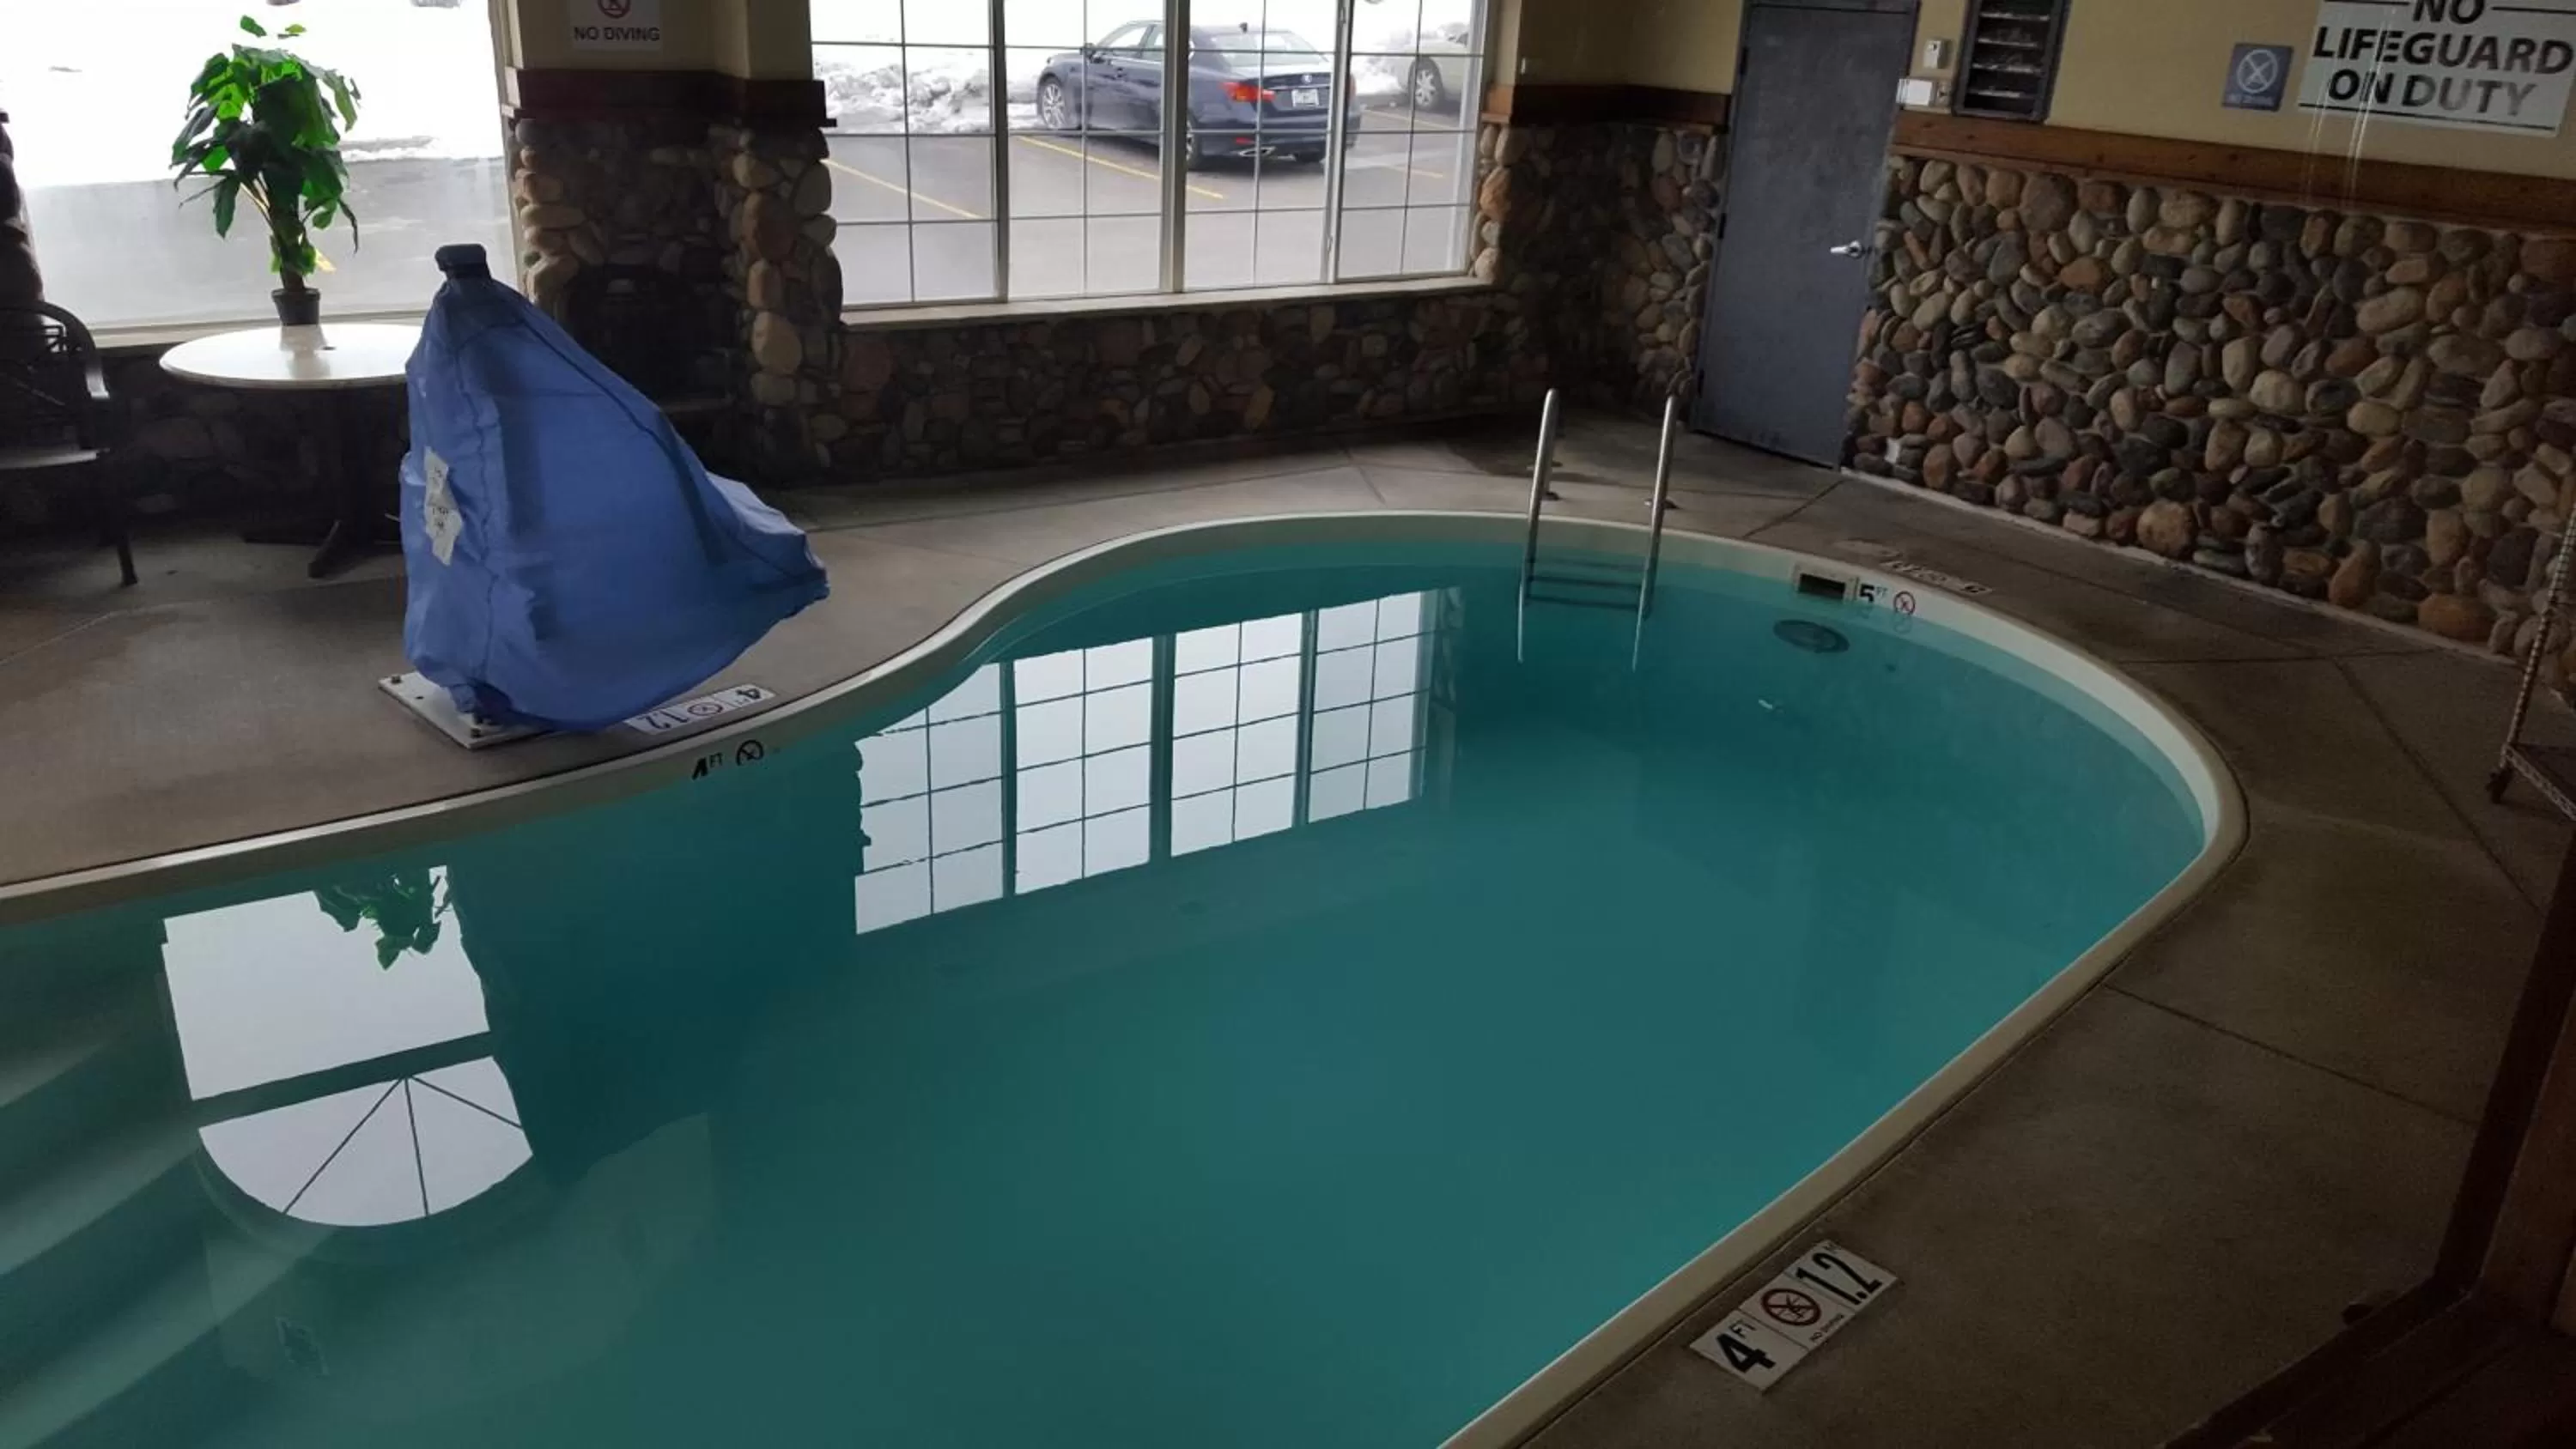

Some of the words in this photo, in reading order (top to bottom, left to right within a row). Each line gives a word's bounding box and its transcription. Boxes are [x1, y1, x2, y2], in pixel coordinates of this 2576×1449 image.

[574, 26, 599, 40] NO
[604, 27, 660, 41] DIVING
[2412, 0, 2484, 24] NO
[2313, 27, 2573, 75] LIFEGUARD
[2328, 70, 2394, 105] ON
[2401, 75, 2537, 116] DUTY
[1796, 1252, 1882, 1306] 1.2
